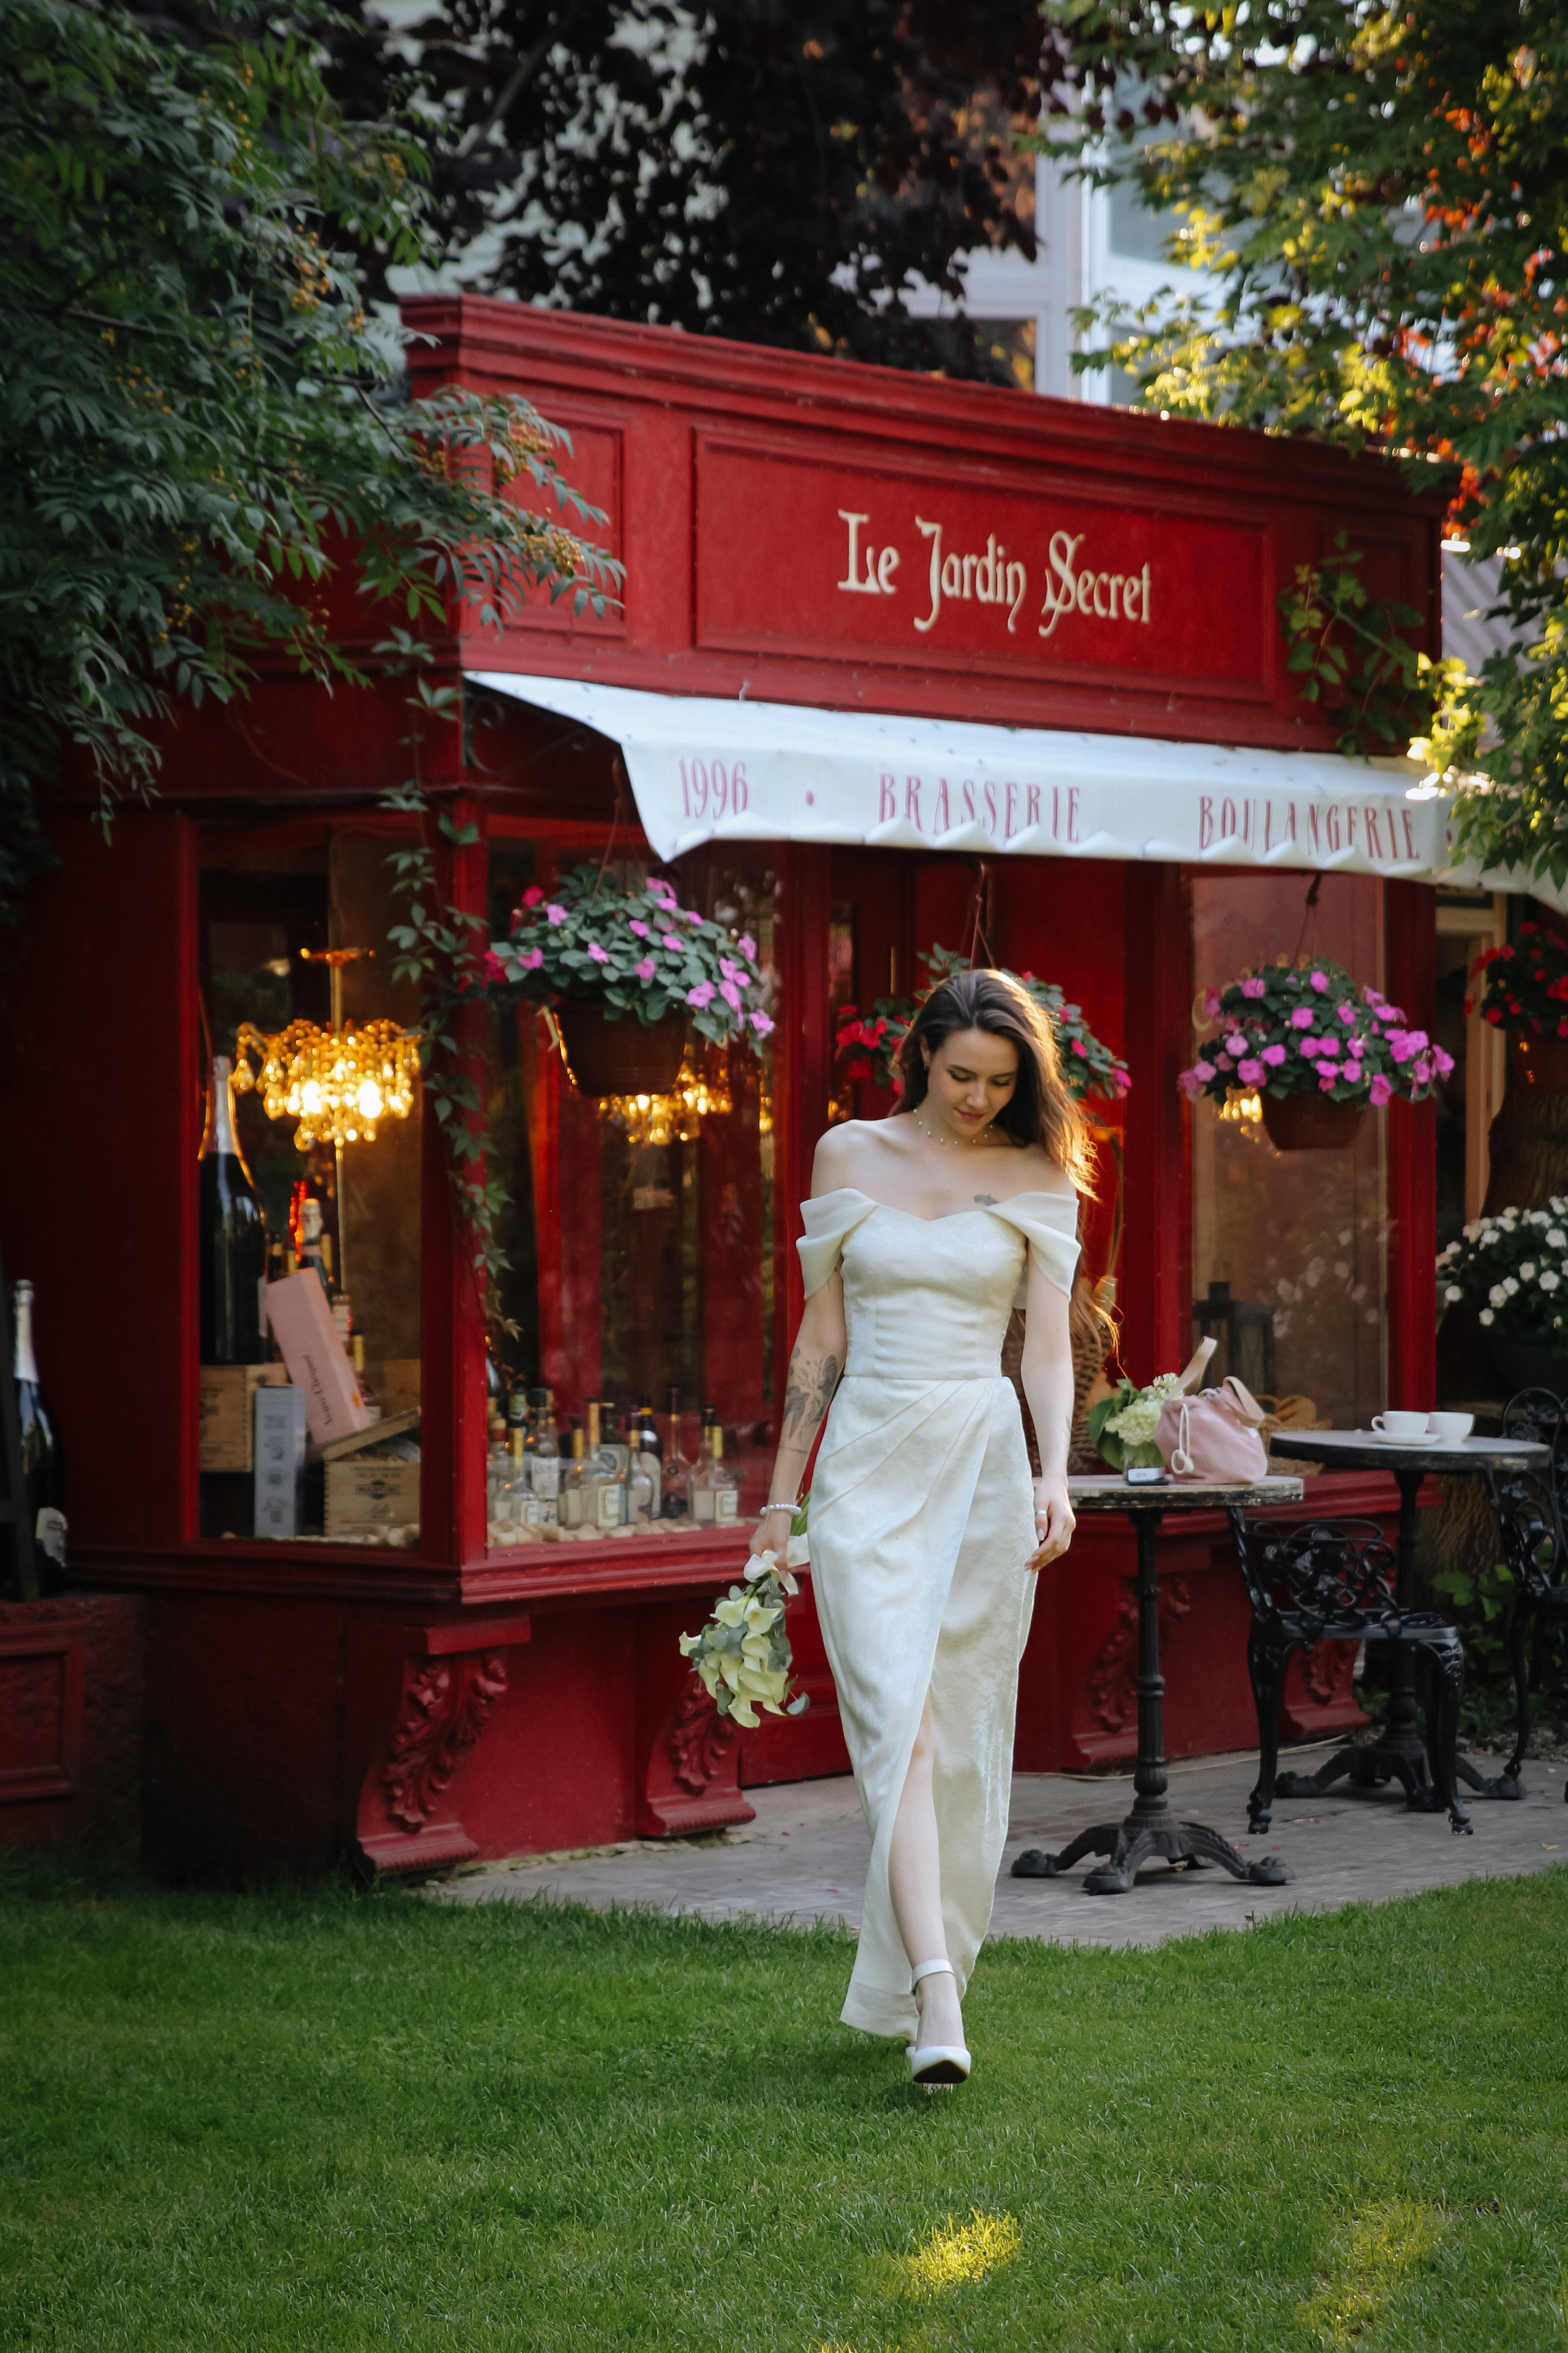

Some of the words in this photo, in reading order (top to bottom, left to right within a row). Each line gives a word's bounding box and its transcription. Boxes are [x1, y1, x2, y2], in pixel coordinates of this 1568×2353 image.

[837, 508, 900, 595] Le
[913, 515, 1027, 633] Jardin
[1038, 530, 1151, 637] Secret
[678, 757, 749, 820] 1996
[878, 772, 1080, 843] BRASSERIE
[1197, 796, 1420, 860] BOULANGERIE
